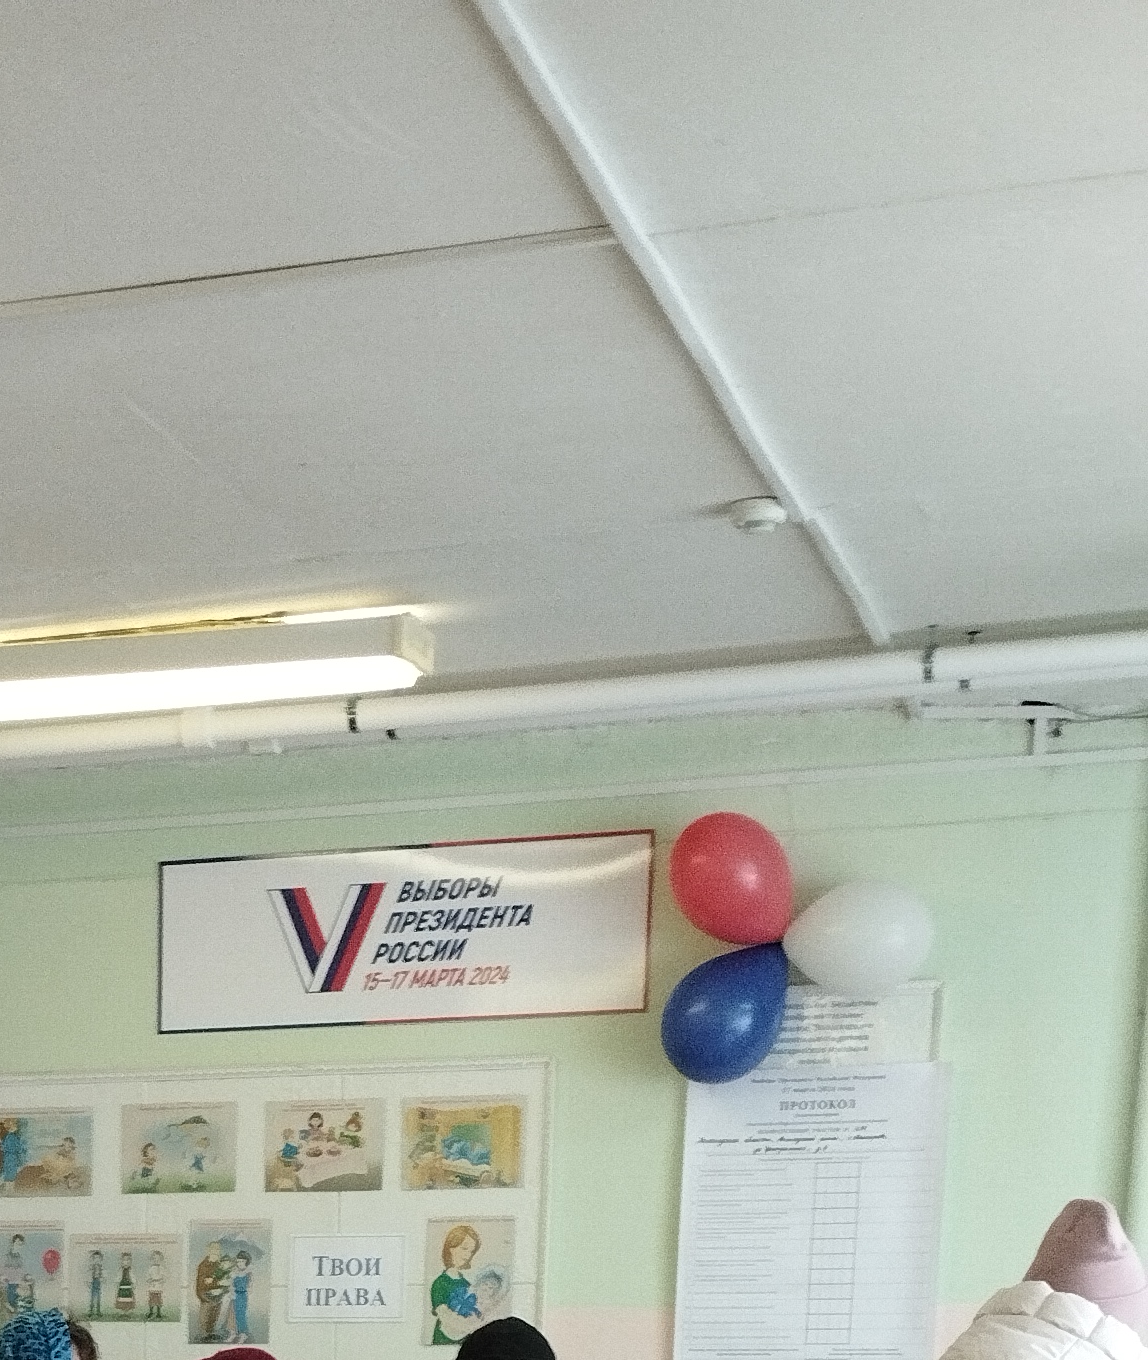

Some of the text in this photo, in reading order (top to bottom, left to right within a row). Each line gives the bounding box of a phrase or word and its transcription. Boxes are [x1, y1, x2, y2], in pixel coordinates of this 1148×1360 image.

[395, 876, 503, 903] ВЫБОРЫ
[384, 904, 534, 934] ПРЕЗИДЕНТА
[371, 938, 468, 964] РОССИИ
[408, 967, 466, 989] МАРТА
[468, 965, 511, 986] 2024
[779, 1099, 856, 1111] ПРОТОКОЛ
[306, 1288, 386, 1306] ПРАВА
